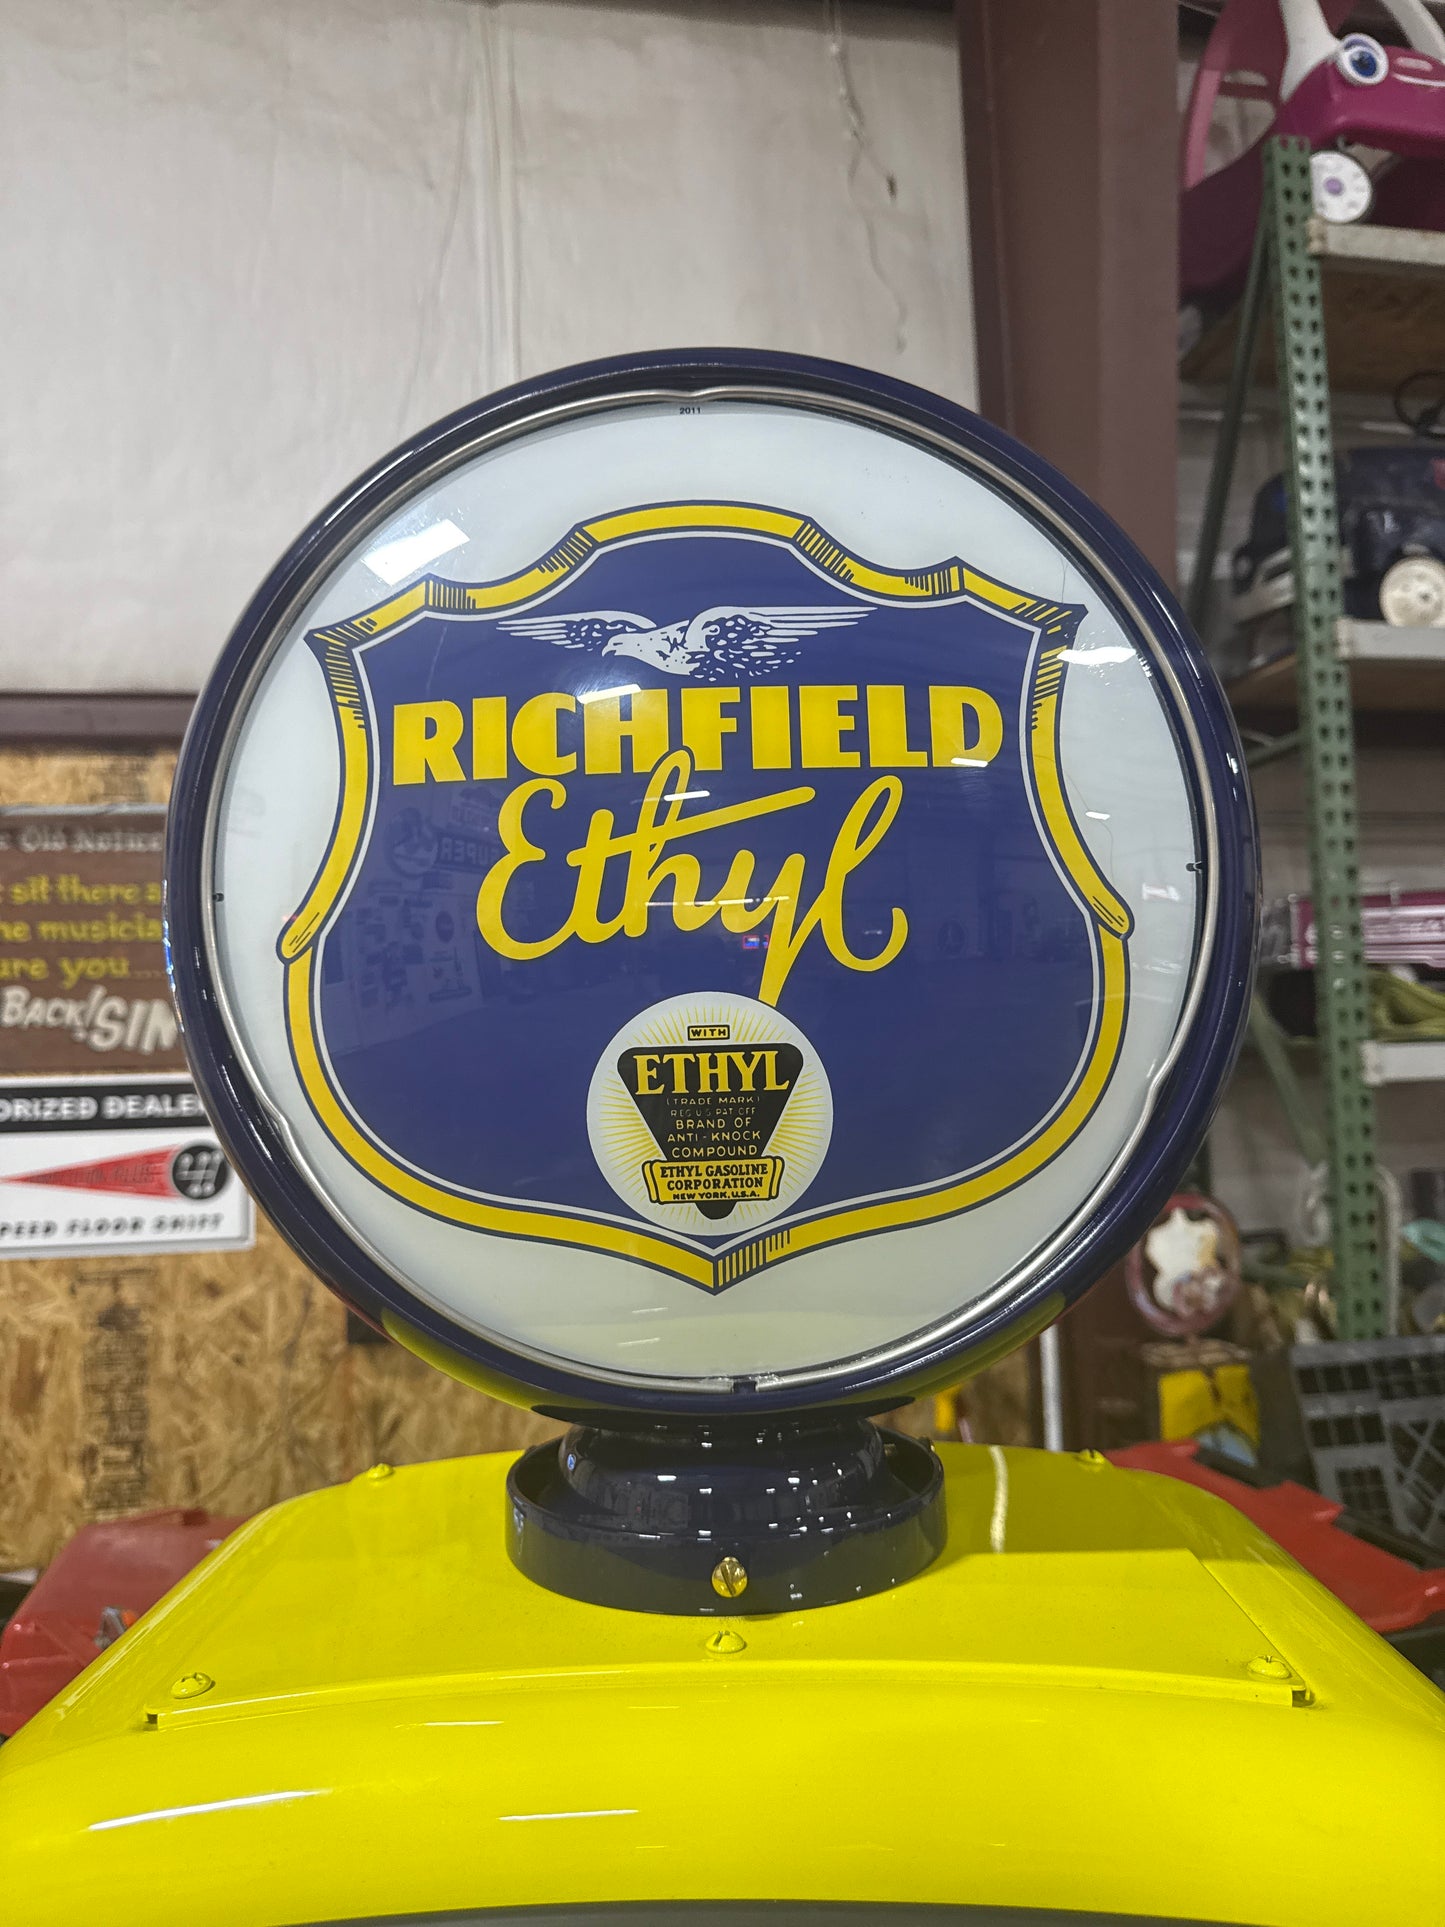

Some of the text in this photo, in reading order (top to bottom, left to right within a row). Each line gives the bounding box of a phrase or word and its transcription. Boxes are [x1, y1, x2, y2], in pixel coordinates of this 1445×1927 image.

[679, 407, 701, 415] 2011
[392, 685, 1003, 786] RICHFIELD
[476, 747, 908, 1007] Ethyl
[56, 872, 142, 905] there
[691, 1029, 727, 1038] WITH
[633, 1051, 790, 1095] ETHYL
[101, 1092, 206, 1119] DEALE
[676, 1117, 752, 1130] BRAND OF
[671, 1145, 758, 1158] COMPOUND
[660, 1163, 769, 1178] ETHYL GASOLINE
[667, 1177, 764, 1191] CORPORATION
